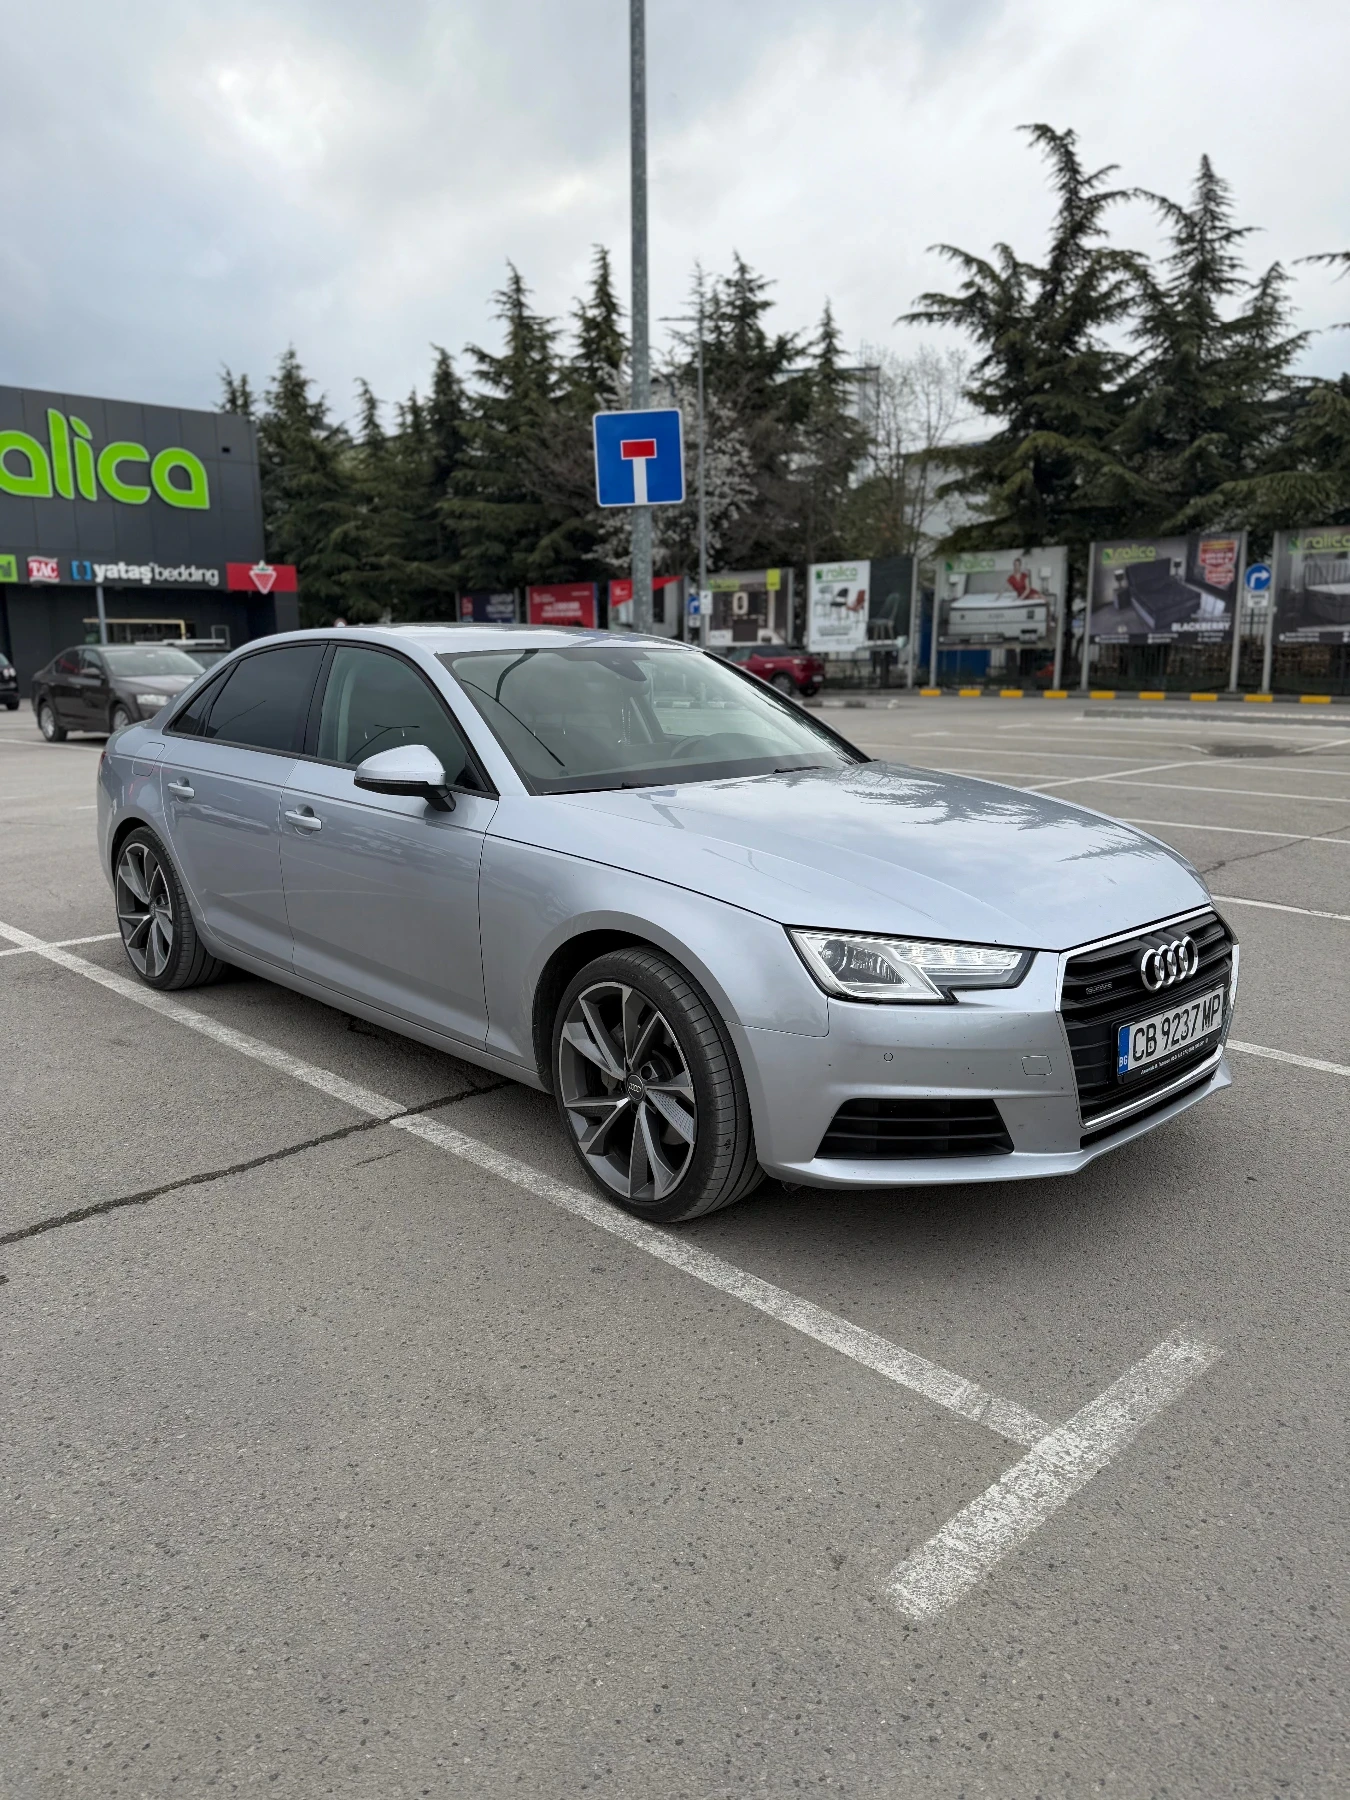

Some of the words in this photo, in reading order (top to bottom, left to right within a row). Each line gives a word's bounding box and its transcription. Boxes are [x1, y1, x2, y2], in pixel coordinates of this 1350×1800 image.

[29, 562, 58, 578] TAC
[1171, 622, 1231, 633] BLACKBERRY
[1132, 1023, 1157, 1062] CB
[1161, 1004, 1200, 1051] 9237
[1201, 993, 1221, 1031] MP
[1119, 1054, 1128, 1068] BG
